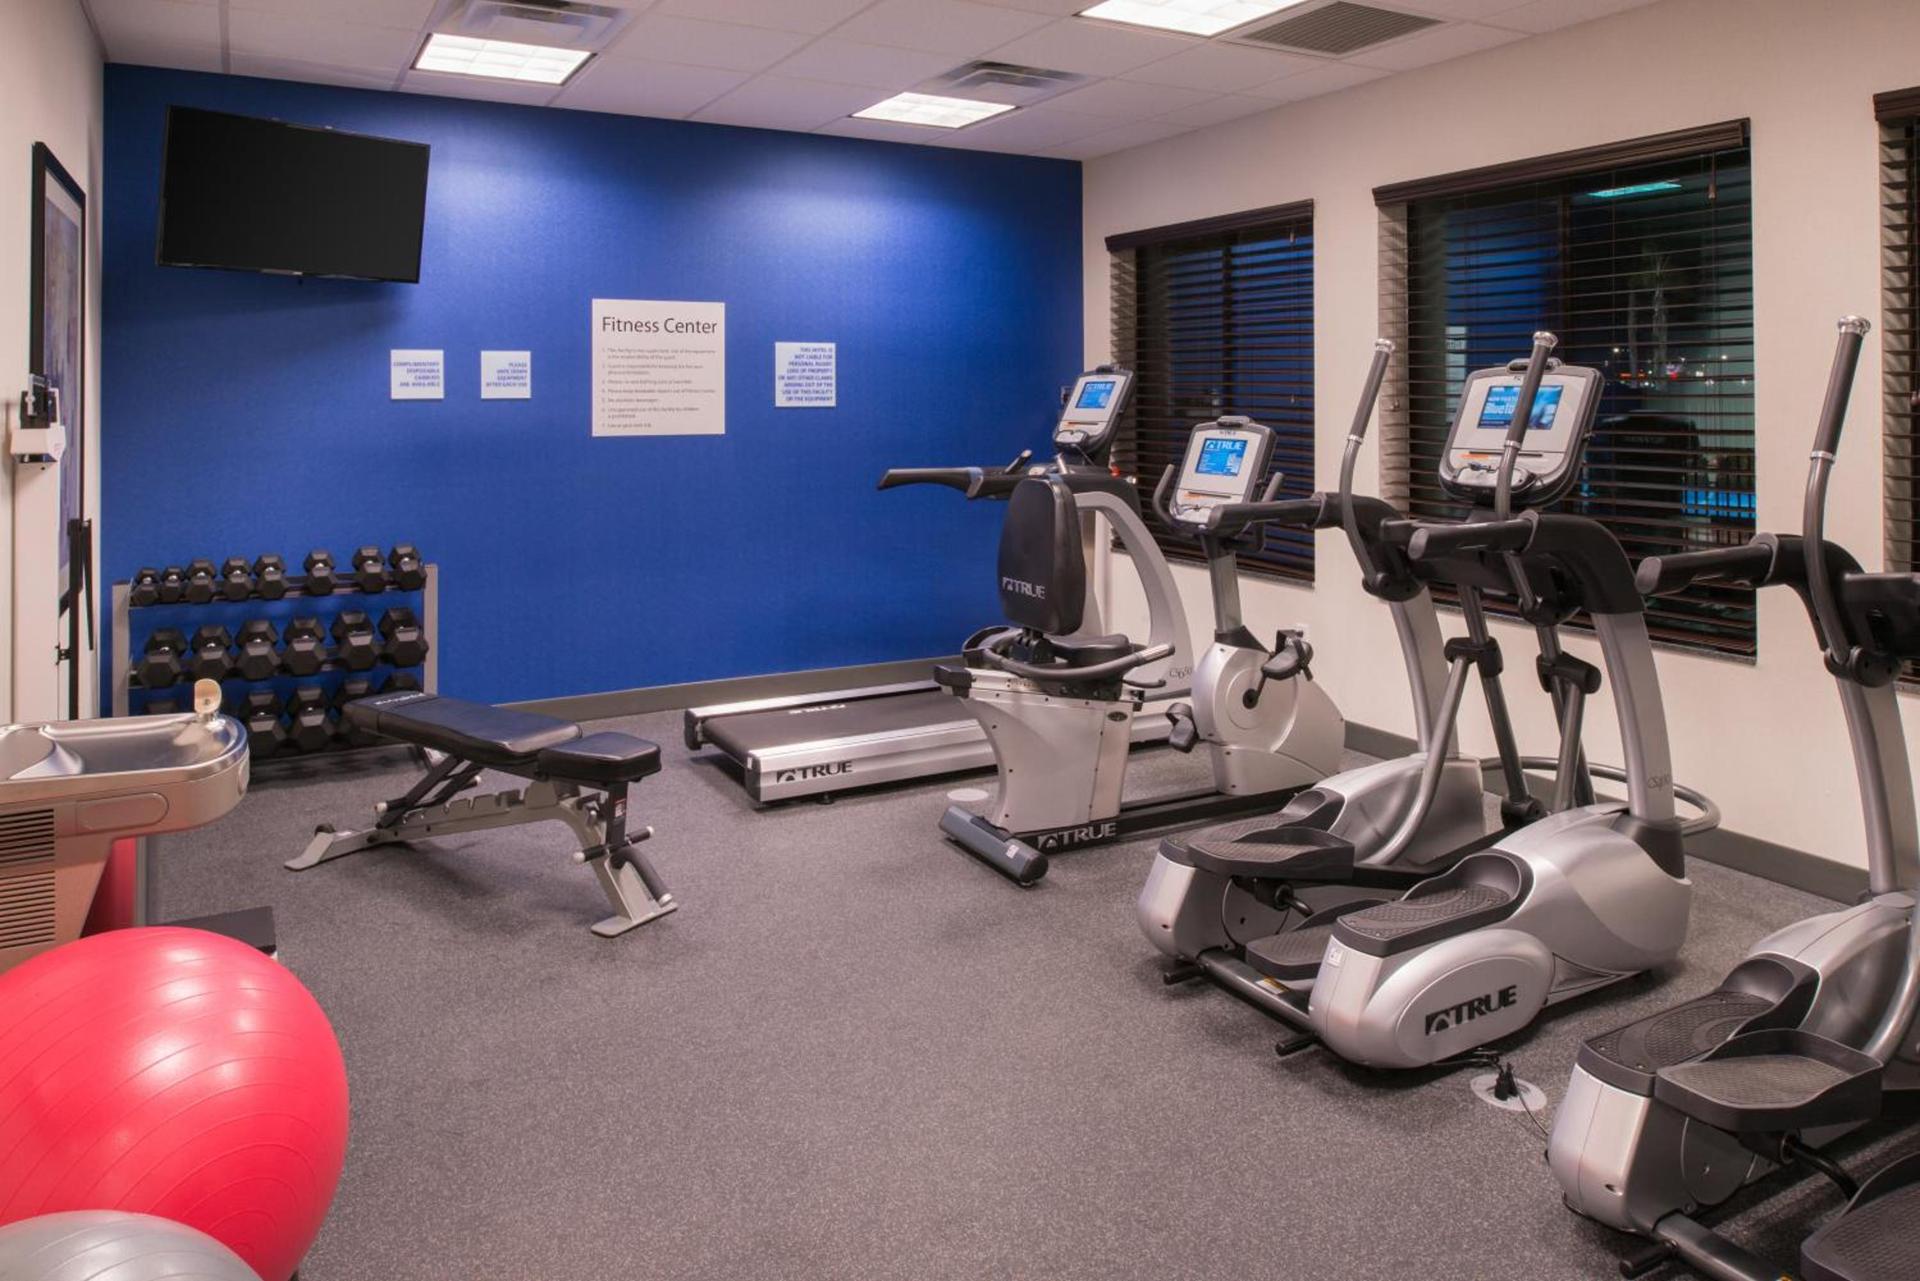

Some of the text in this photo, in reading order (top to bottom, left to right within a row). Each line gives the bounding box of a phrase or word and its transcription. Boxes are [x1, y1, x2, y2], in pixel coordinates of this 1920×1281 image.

[601, 316, 718, 335] Fitness Center
[1216, 440, 1246, 450] TRUE
[1013, 579, 1046, 600] TRUE
[798, 760, 854, 781] TRUE
[1056, 822, 1118, 844] TRUE
[1453, 984, 1517, 1025] TRUE
